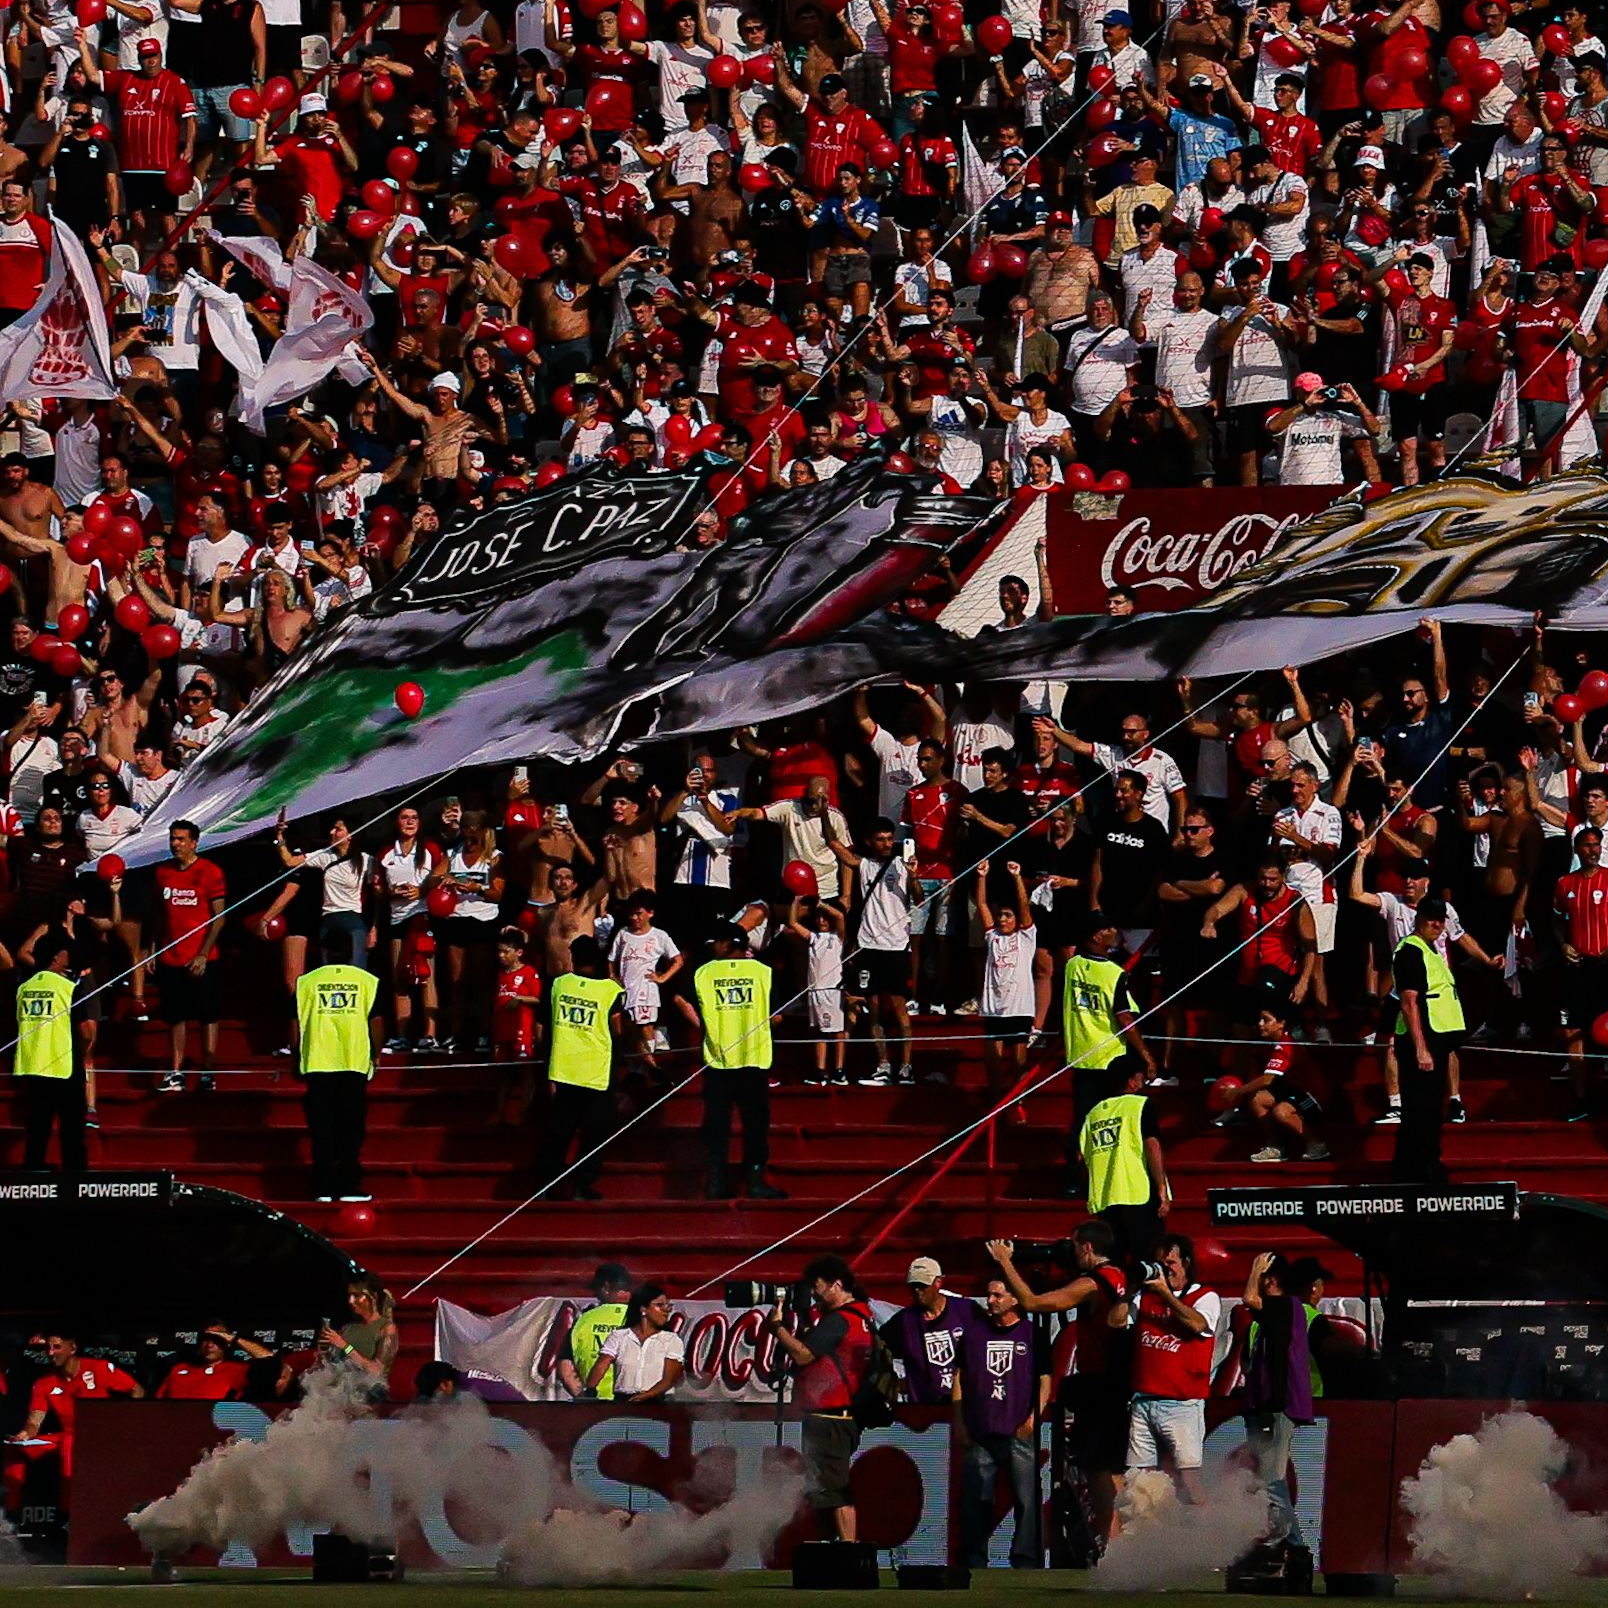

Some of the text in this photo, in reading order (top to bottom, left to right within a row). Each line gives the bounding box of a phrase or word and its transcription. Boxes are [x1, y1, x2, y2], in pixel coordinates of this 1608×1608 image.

[434, 496, 674, 584] JOSE C. PAZ
[1107, 832, 1145, 848] adidas
[171, 888, 196, 897] Banco
[171, 897, 198, 906] Ciudad
[78, 1180, 159, 1198] POWERADE
[1217, 1194, 1505, 1219] POWERADE POWERADE POWERADE
